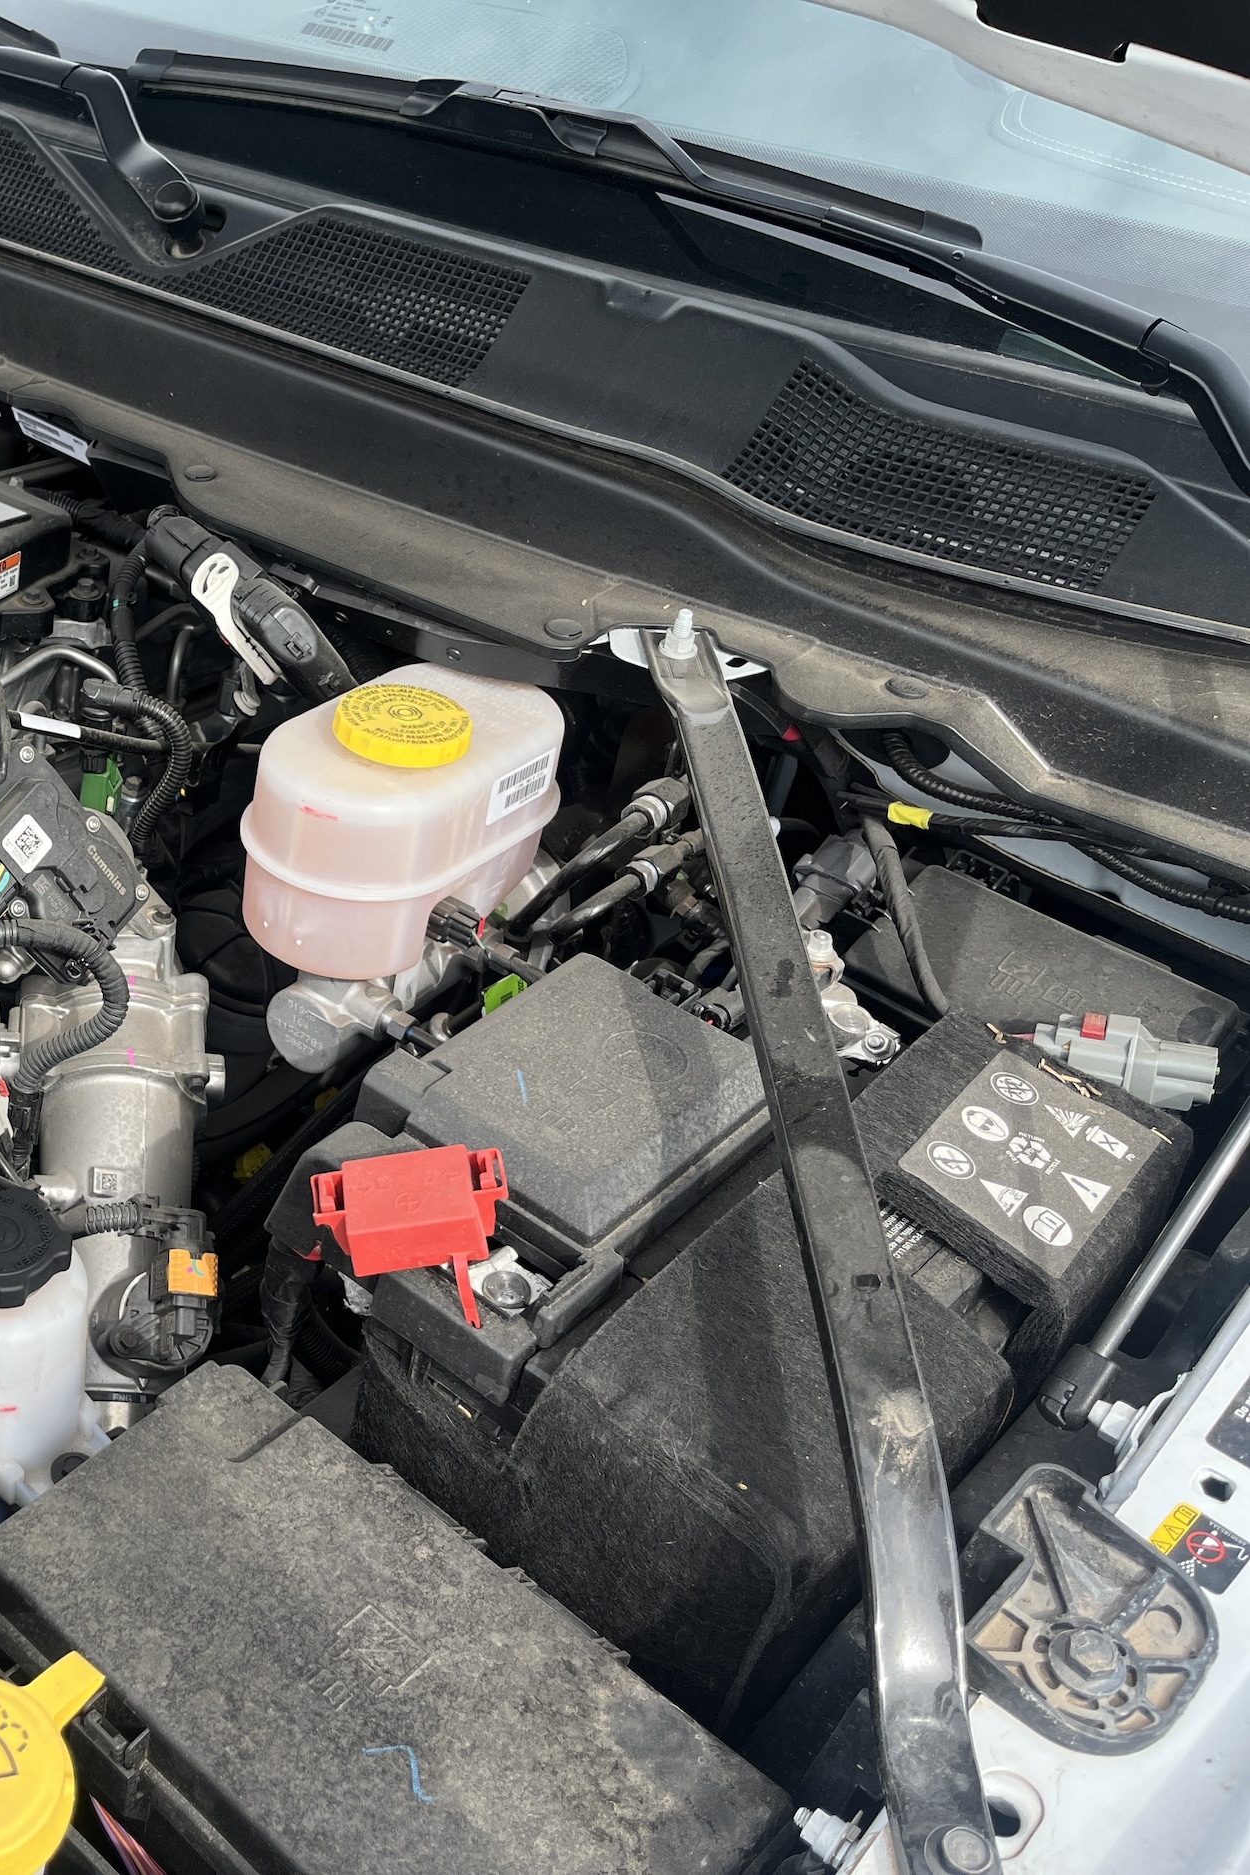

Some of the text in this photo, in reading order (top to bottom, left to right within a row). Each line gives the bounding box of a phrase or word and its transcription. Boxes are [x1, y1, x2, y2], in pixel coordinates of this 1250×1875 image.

[87, 845, 127, 895] Cummins
[1018, 1131, 1045, 1143] RETURN
[1045, 1158, 1061, 1175] RECYCLE
[1234, 1405, 1249, 1419] Do
